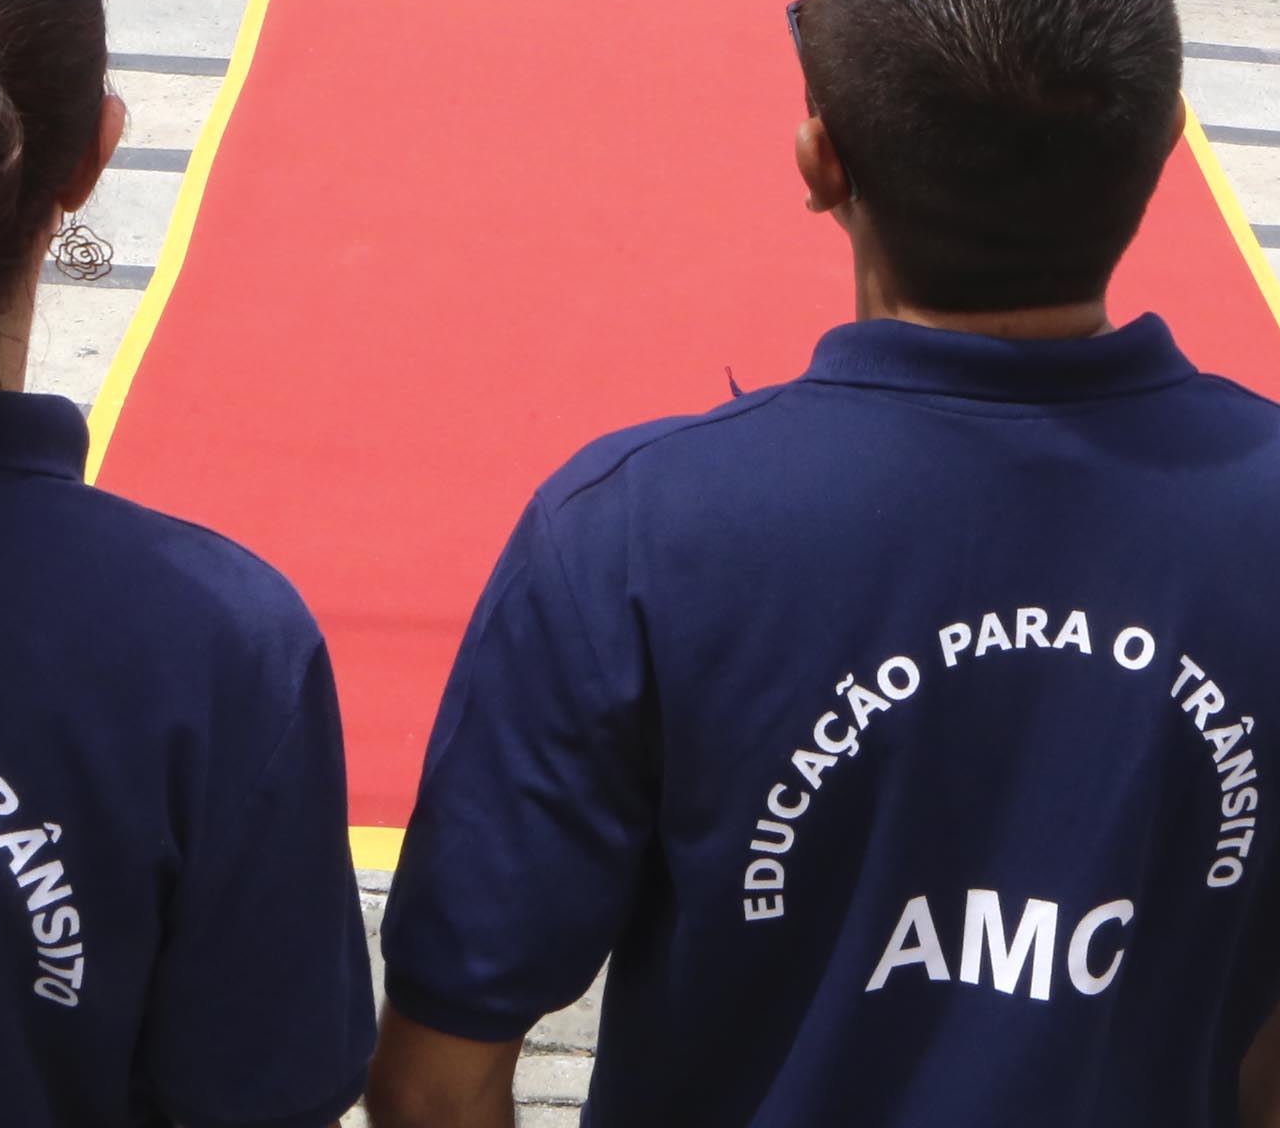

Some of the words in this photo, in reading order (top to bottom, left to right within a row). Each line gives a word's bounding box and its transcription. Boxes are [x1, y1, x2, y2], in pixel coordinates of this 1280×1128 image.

[744, 656, 920, 921] EDUCAÇÃO
[938, 607, 1092, 667] PARA
[1112, 626, 1156, 670] O
[1170, 654, 1259, 888] TRÂNSITO
[864, 888, 1135, 1001] AMC
